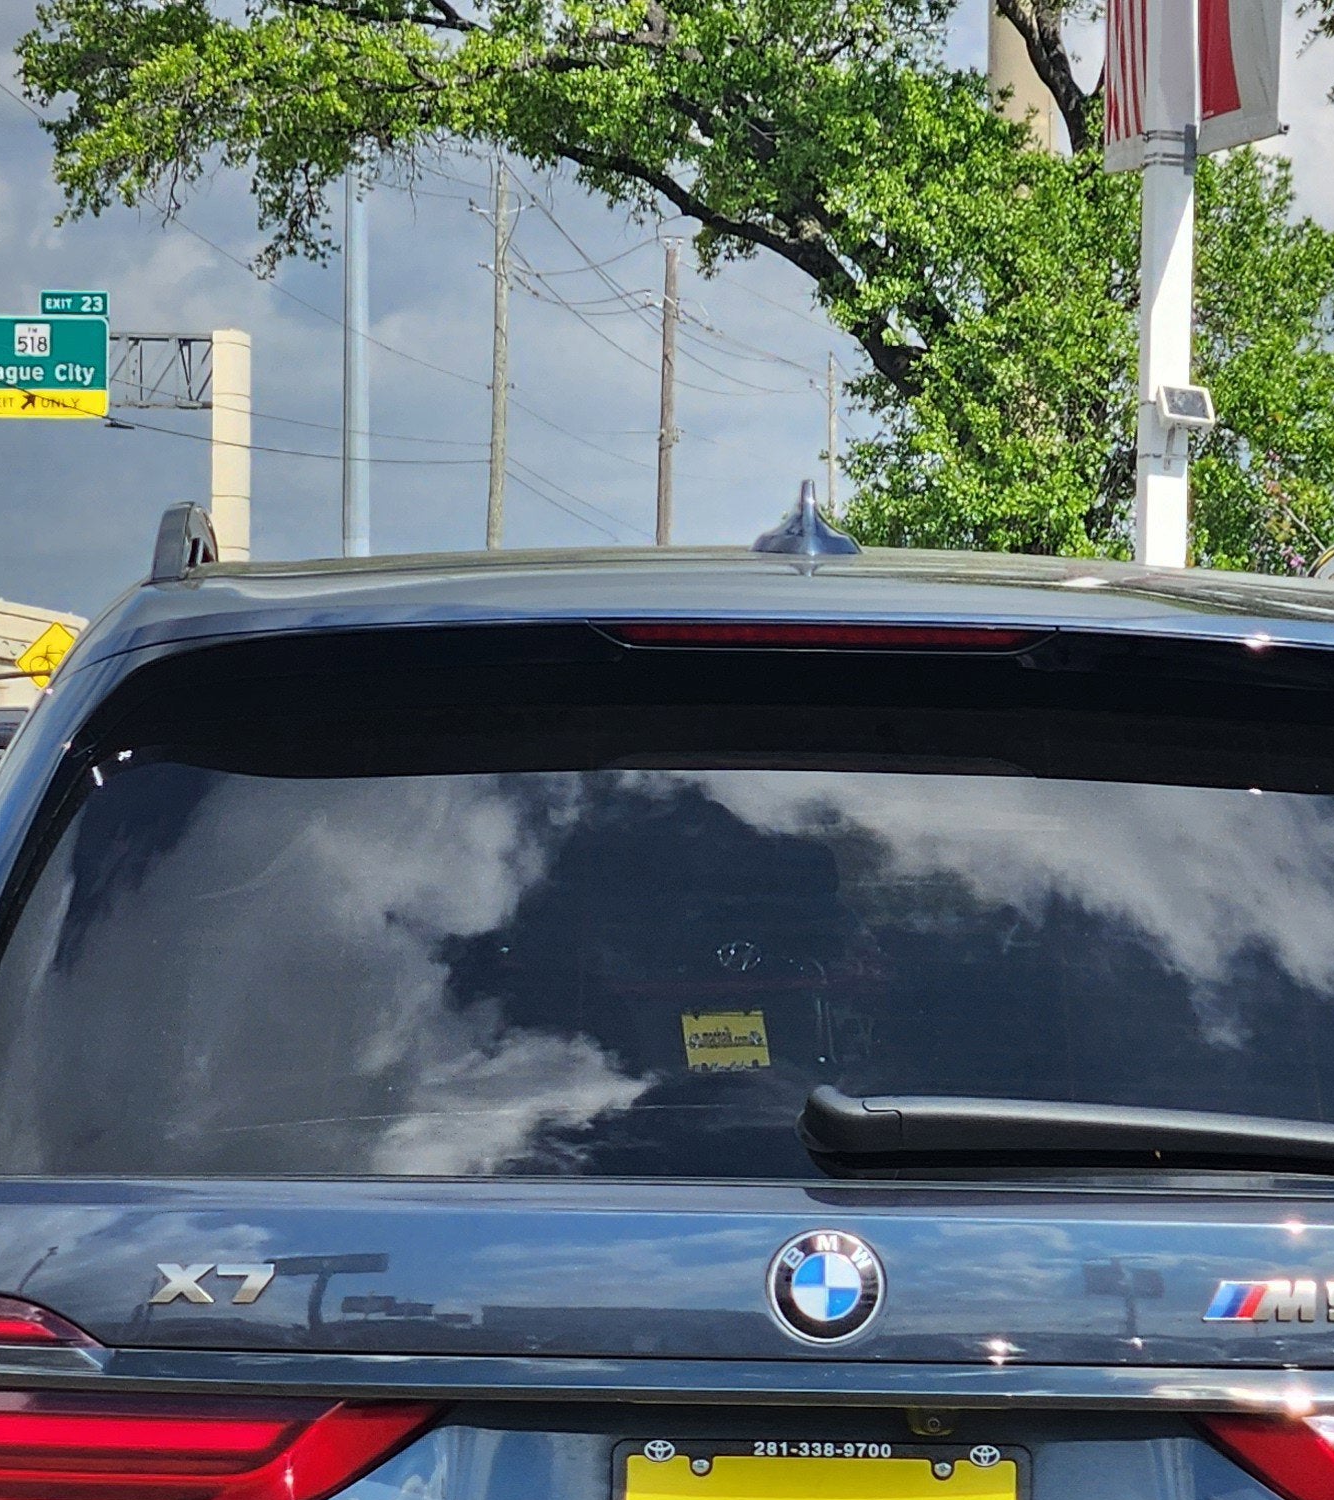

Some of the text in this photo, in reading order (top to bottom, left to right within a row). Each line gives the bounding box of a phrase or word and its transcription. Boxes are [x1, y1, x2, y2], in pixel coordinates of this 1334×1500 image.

[45, 296, 104, 312] EXIT 23
[17, 336, 47, 353] 518
[55, 363, 95, 386] City
[41, 397, 80, 409] ONLY
[782, 1234, 873, 1270] BMW
[148, 1263, 276, 1304] X7
[753, 1440, 892, 1459] 281-338-9700
